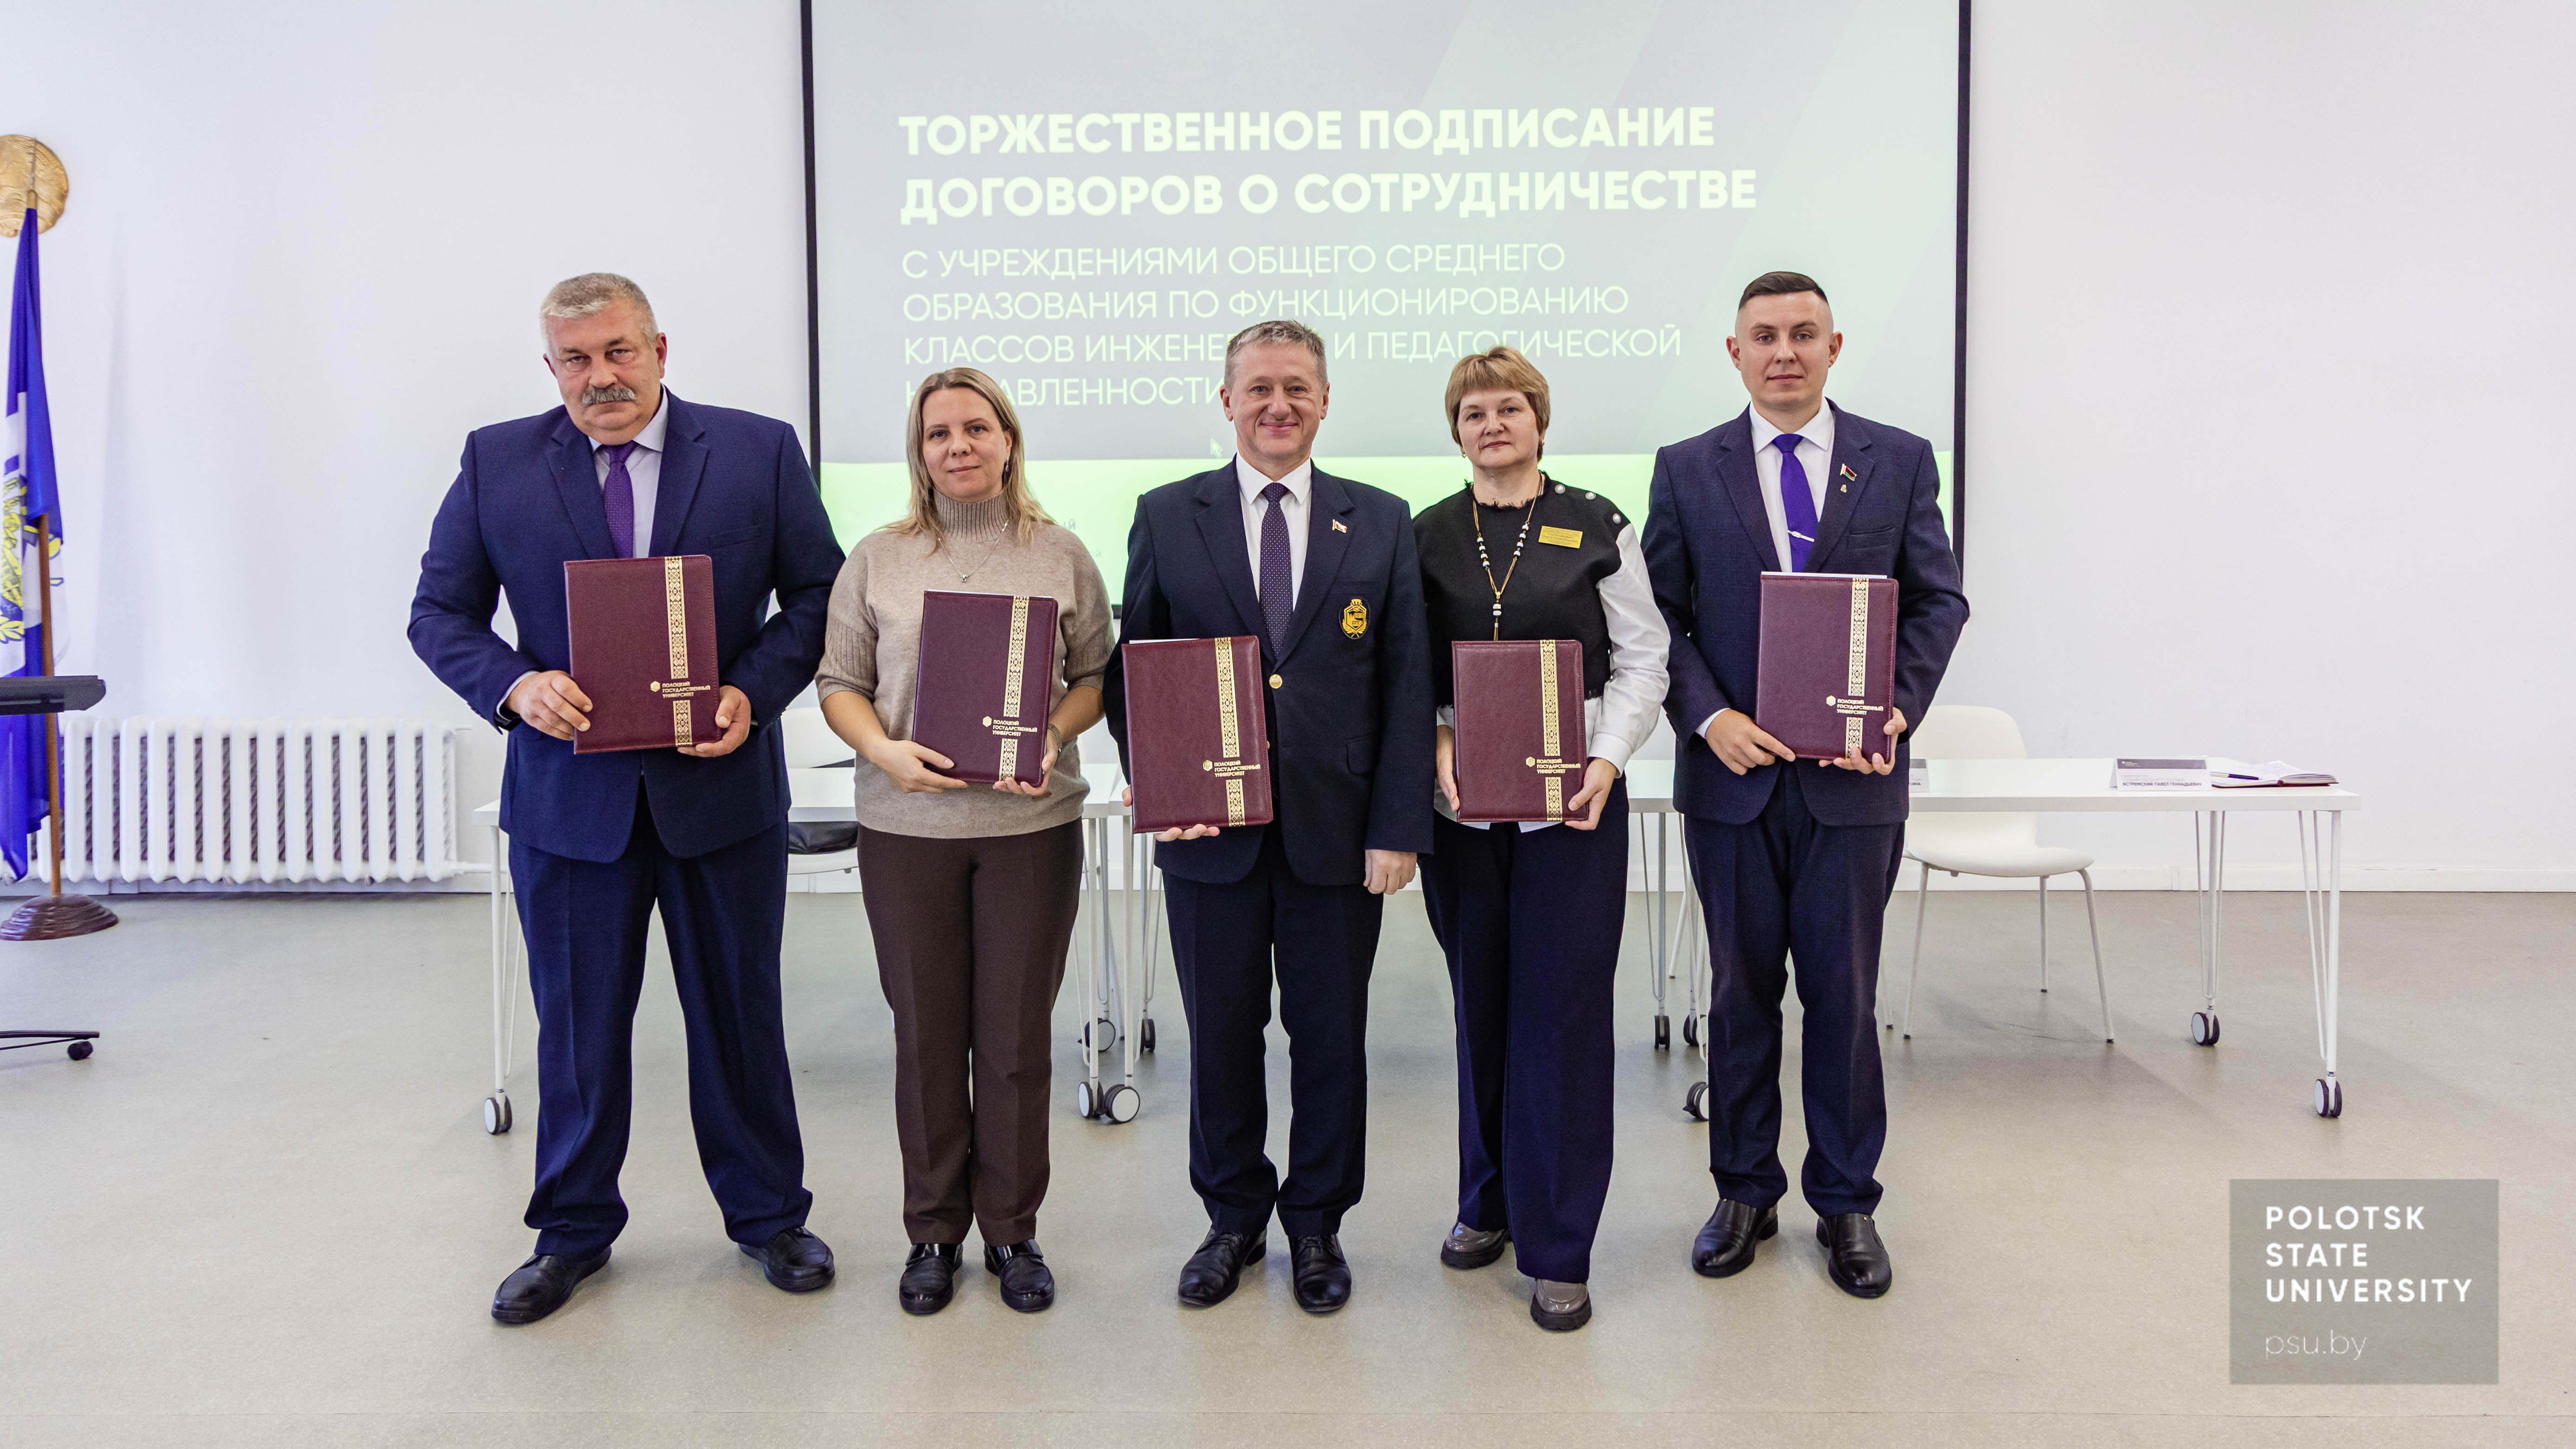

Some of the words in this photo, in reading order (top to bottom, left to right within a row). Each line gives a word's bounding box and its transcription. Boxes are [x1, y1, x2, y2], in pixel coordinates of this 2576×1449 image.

[898, 110, 1342, 155] ТОРЖЕСТВЕННОЕ
[1360, 107, 1714, 156] ПОДПИСАНИЕ
[900, 175, 1223, 225] ДОГОВОРОВ
[1239, 174, 1278, 214] О
[1294, 169, 1757, 218] СОТРУДНИЧЕСТВЕ
[902, 250, 928, 279] С
[938, 247, 1217, 281] УЧРЕЖДЕНИЯМИ
[1228, 244, 1376, 278] ОБЩЕГО
[1386, 243, 1565, 276] СРЕДНЕГО
[903, 291, 1157, 322] ОБРАЗОВАНИЯ
[1169, 290, 1219, 319] ПО
[1229, 285, 1629, 321] ФУНКЦИОНИРОВАНИЮ
[905, 335, 1074, 365] КЛАССОВ
[1086, 328, 1322, 362] ИНЖЕНЕ
[1334, 332, 1356, 360] И
[1368, 324, 1681, 363] ПЕДАГОГИЧЕСКОЙ
[906, 377, 1225, 407] НАВЛЕННОСТИ
[1214, 764, 1261, 772] ГОСУДАРСТВЕННЫЙ
